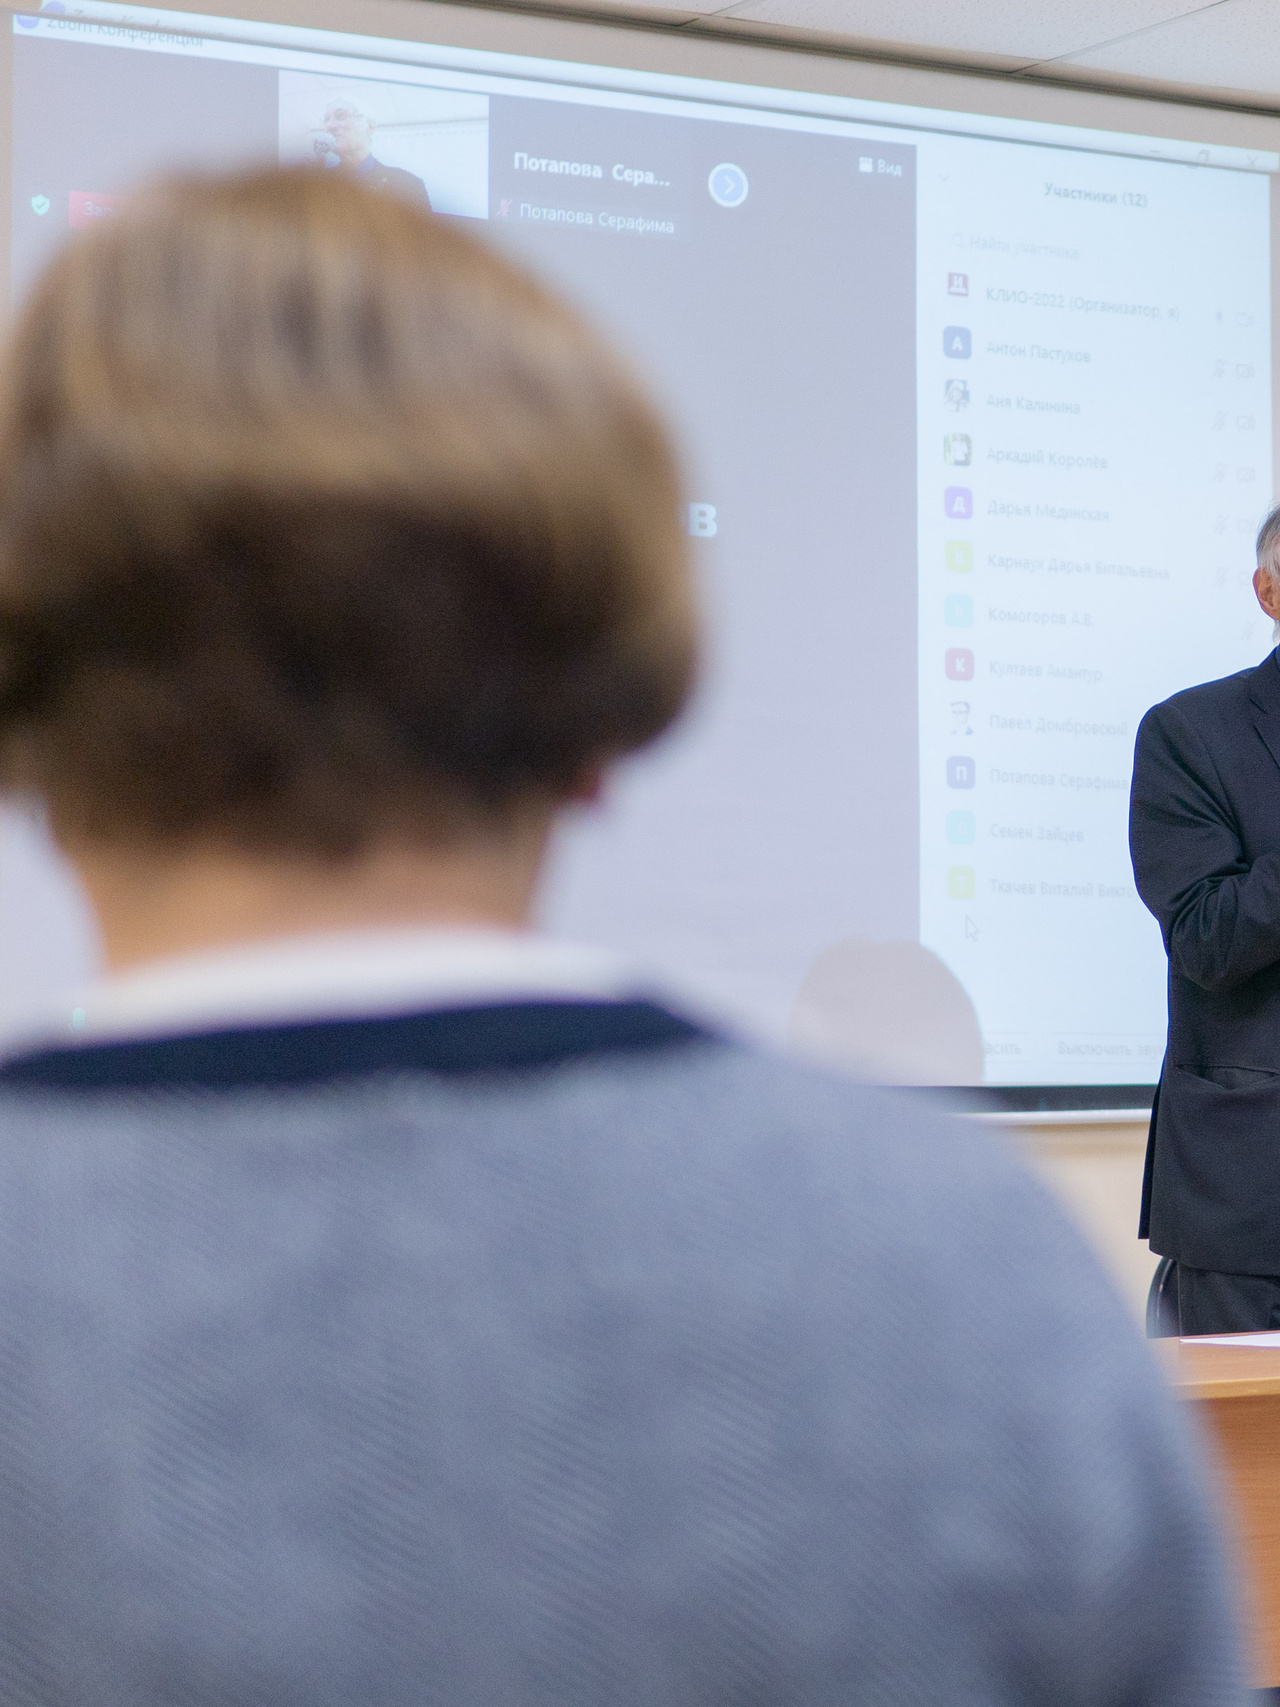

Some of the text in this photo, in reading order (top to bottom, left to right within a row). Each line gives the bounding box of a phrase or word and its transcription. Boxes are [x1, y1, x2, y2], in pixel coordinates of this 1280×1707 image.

[513, 151, 671, 188] Потапова Сера...
[877, 158, 903, 179] Вид
[1043, 182, 1149, 210] Участники (12)
[519, 201, 675, 235] Потапова Серафима
[969, 234, 1010, 254] Найти
[986, 287, 1065, 309] КЛИО-2022
[951, 336, 964, 352] А
[986, 340, 1092, 365] Антон Пастухов
[986, 393, 1081, 415] Аня Калинина
[987, 446, 1109, 471] Аркадий Королёв
[952, 496, 966, 513] Д
[987, 500, 1110, 523] Дарья Мединская
[988, 554, 1170, 581] Карнаух Дарья Витальевна
[988, 607, 1067, 627] Комогоров
[954, 657, 966, 673] К
[989, 660, 1103, 683] Култаев Амантур
[989, 714, 1128, 738] Павел Домбровский
[956, 766, 968, 781] П
[990, 769, 1127, 792] Потапова Серафима
[990, 823, 1085, 843] Семен Зайцев
[990, 878, 1036, 895] Ткачев
[1098, 883, 1135, 899] Викто
